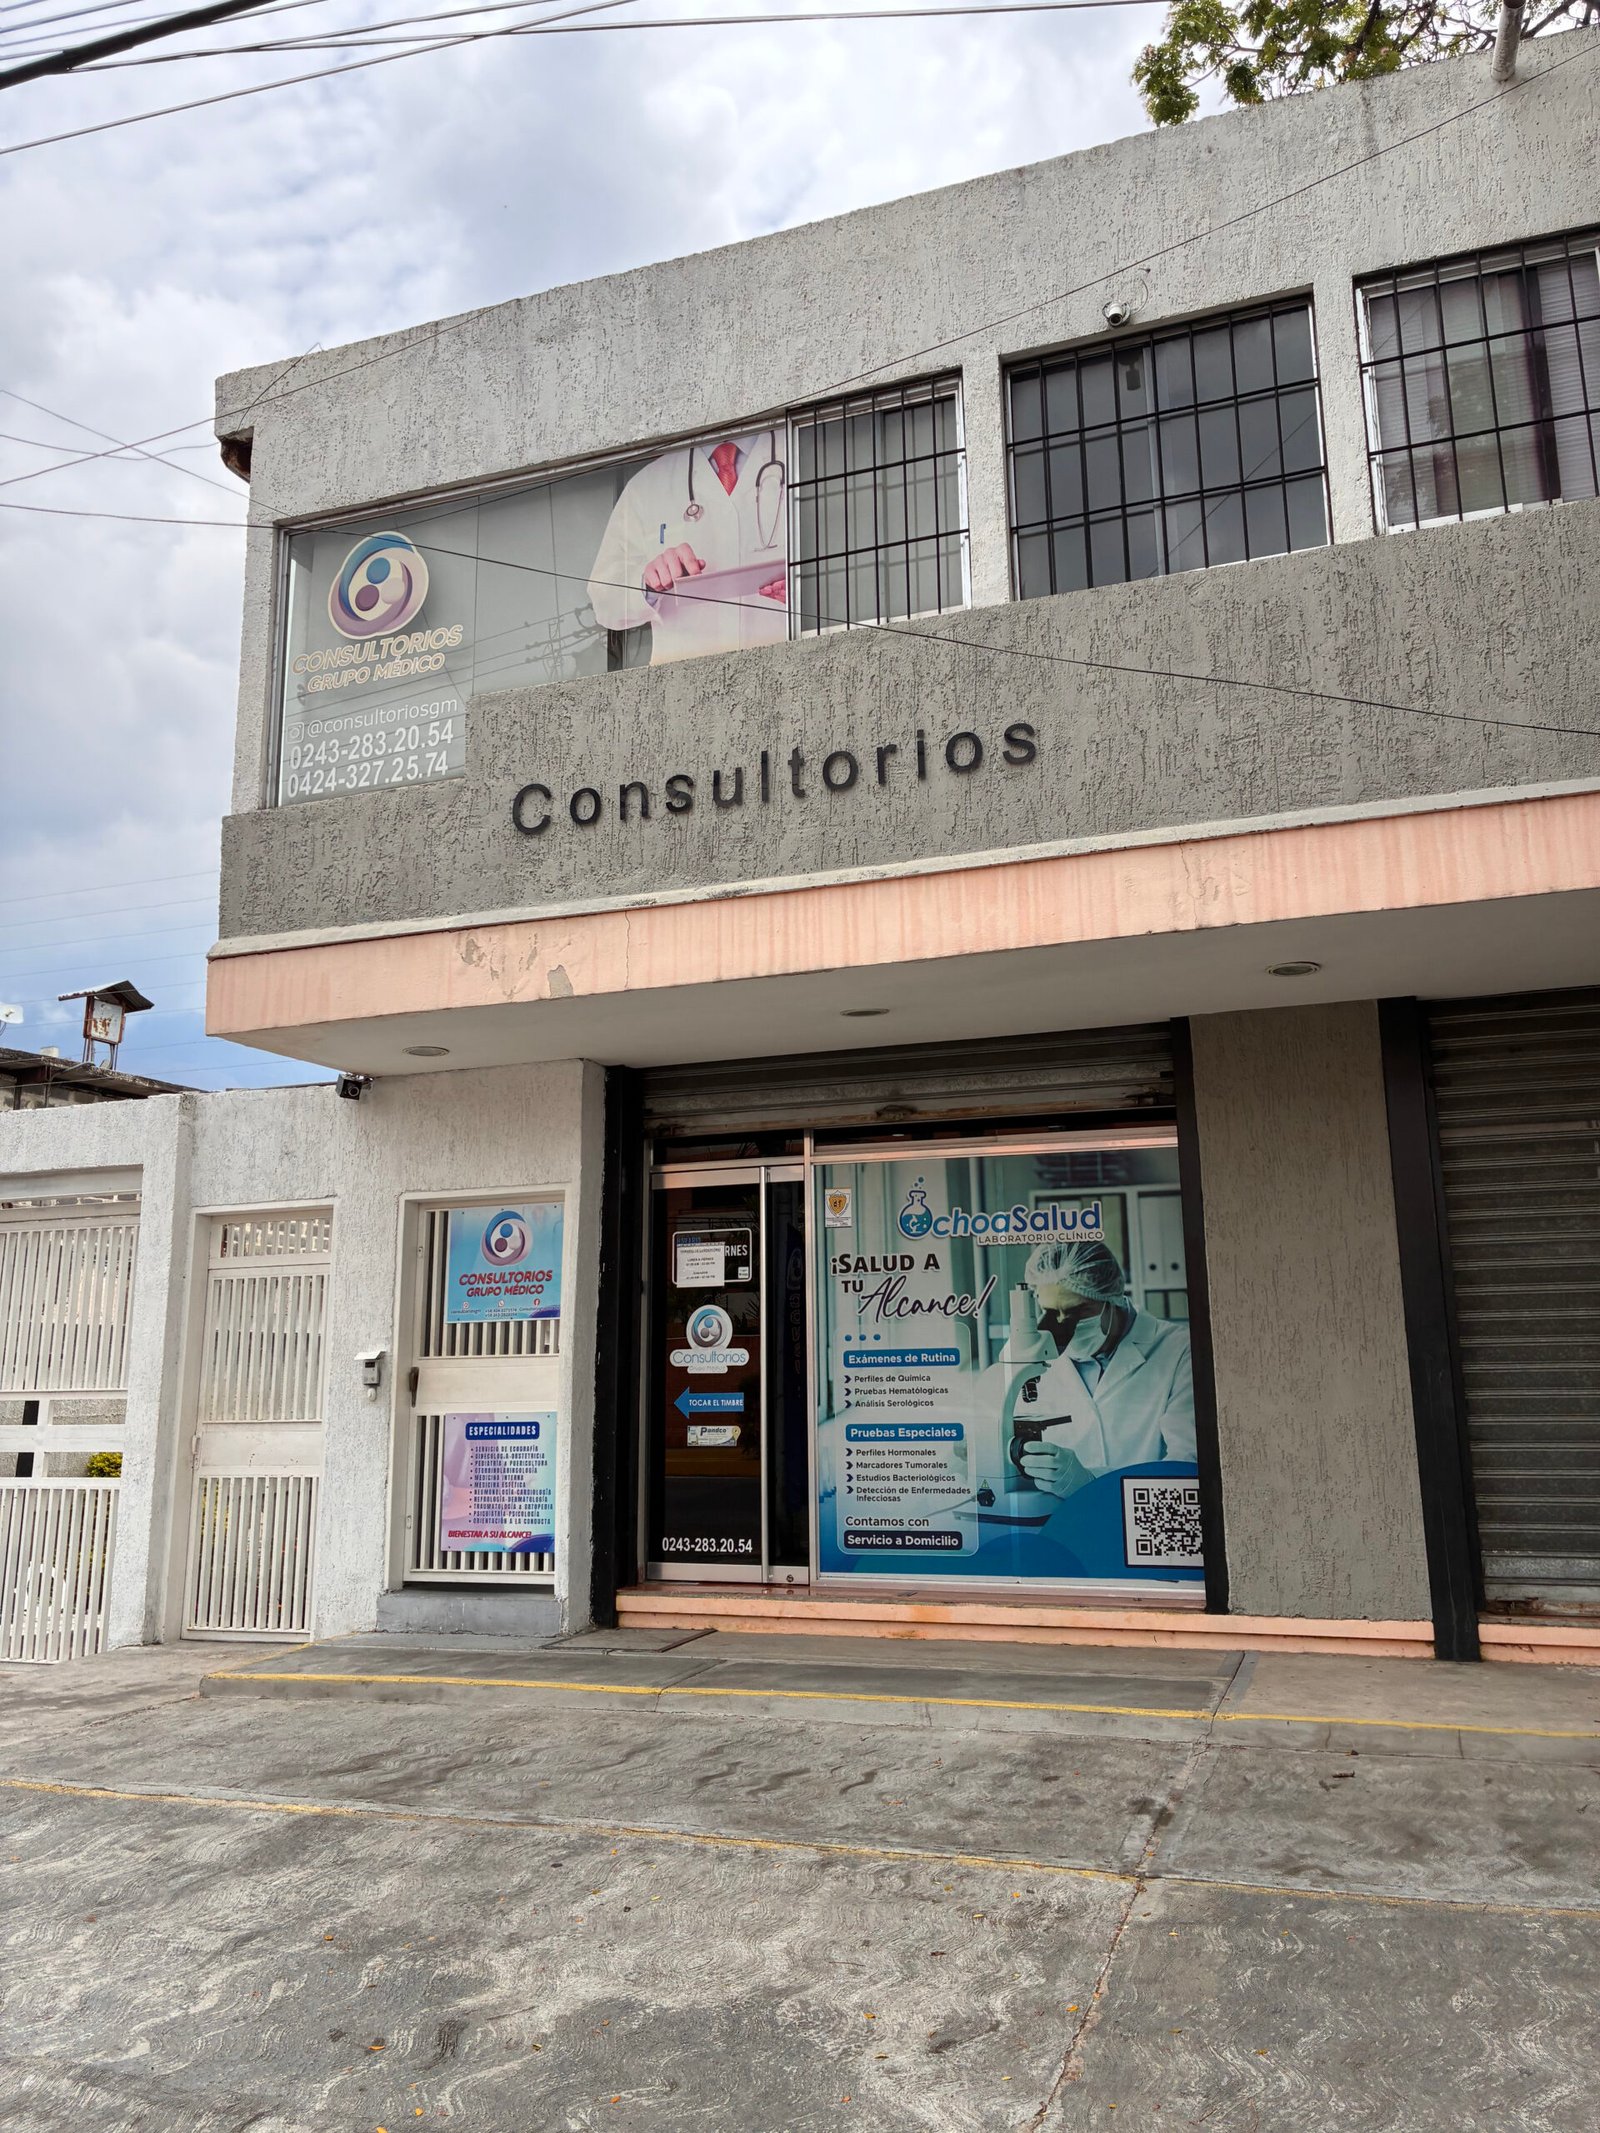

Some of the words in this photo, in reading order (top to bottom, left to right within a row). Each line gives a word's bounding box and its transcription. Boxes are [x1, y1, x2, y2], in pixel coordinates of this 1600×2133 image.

[291, 625, 464, 675] CONSULTORIOS
[308, 666, 370, 693] GRUPO
[373, 652, 446, 683] MÉDICO
[308, 698, 459, 738] @consultoriosgm
[289, 719, 454, 770] 0243-283.20.54
[287, 750, 450, 798] 0424-327.25.74
[511, 721, 1037, 836] Consultorios
[978, 1232, 1056, 1245] LABORATORIO
[1058, 1229, 1104, 1242] CLÍNICO
[724, 1244, 748, 1257] RNES
[830, 1253, 915, 1275] ¡SALUD
[923, 1252, 940, 1271] A
[459, 1270, 553, 1286] CONSULTORIOS
[466, 1286, 502, 1297] GRUPO
[503, 1282, 544, 1296] MÉDICO
[841, 1280, 864, 1294] TU
[858, 1275, 998, 1323] Alcance!
[672, 1351, 746, 1364] Consultorios
[849, 1353, 902, 1364] Exámenes
[904, 1353, 918, 1363] de
[921, 1352, 956, 1363] Rutina
[854, 1375, 884, 1383] Perfiles
[689, 1399, 711, 1407] TOCAR
[855, 1399, 885, 1408] Análisis
[887, 1399, 934, 1408] Serológicos
[469, 1425, 537, 1436] ESPECIALIDADES
[850, 1428, 896, 1438] Pruebas
[898, 1427, 957, 1439] Especiales
[856, 1448, 886, 1456] Perfiles
[887, 1448, 937, 1456] Hormonales
[856, 1461, 903, 1469] Marcadores
[905, 1461, 948, 1469] Tumorales
[856, 1474, 891, 1482] Estudios
[892, 1474, 956, 1483] Bacteriológicos
[856, 1486, 897, 1494] Detección
[898, 1486, 909, 1494] de
[911, 1486, 971, 1494] Enfermedades
[856, 1494, 901, 1502] Infecciosas
[845, 1516, 905, 1527] Contamos
[907, 1518, 930, 1527] con
[448, 1530, 482, 1538] BIENESTAR
[847, 1534, 893, 1545] Servicio
[895, 1537, 902, 1545] a
[905, 1535, 959, 1546] Domicilio
[661, 1537, 753, 1553] 0243-283.20.54
